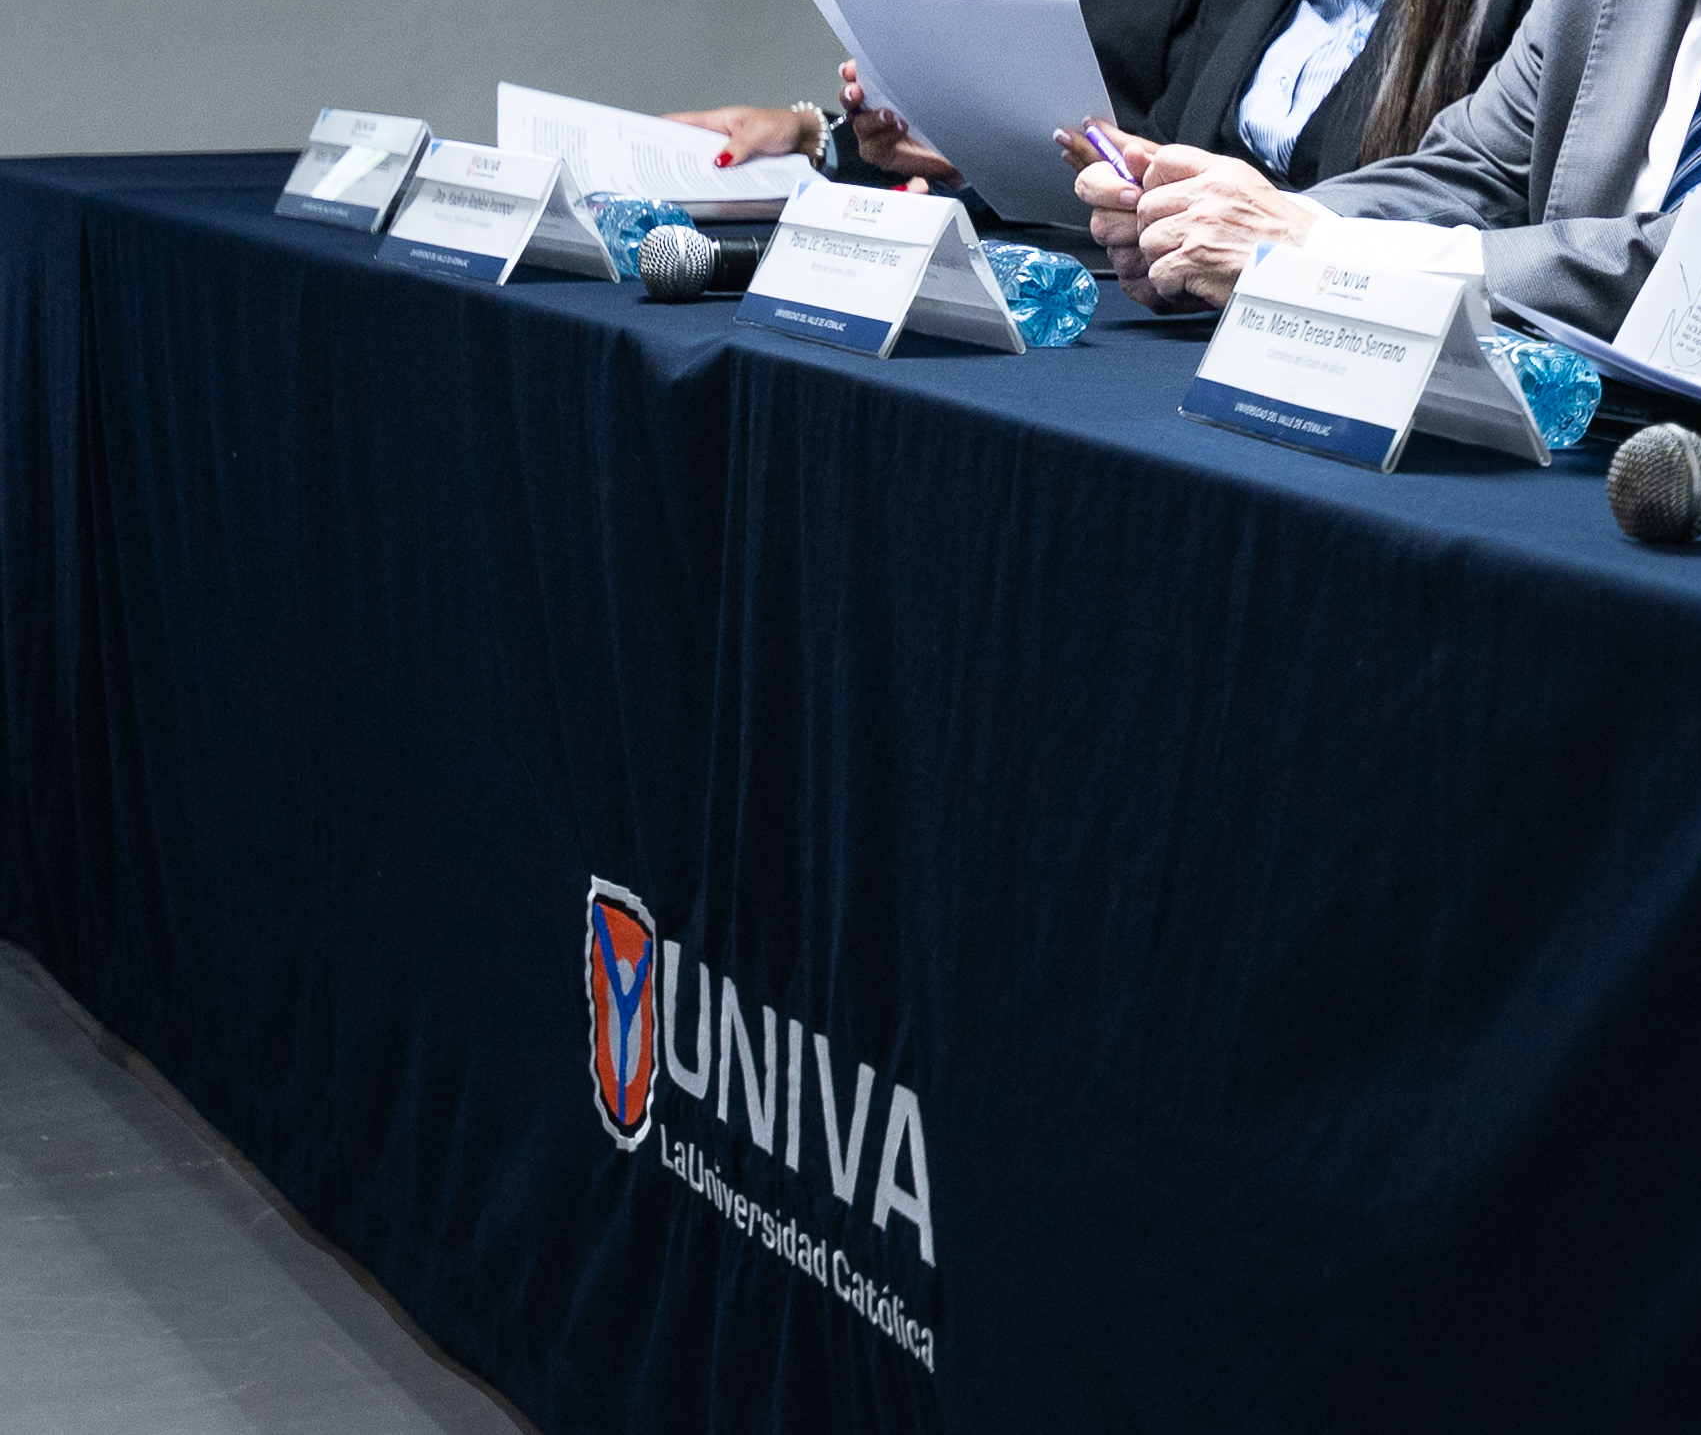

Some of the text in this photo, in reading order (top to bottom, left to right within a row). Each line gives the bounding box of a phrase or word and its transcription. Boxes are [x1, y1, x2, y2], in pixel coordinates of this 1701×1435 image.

[1331, 269, 1371, 292] UNIVA
[1236, 306, 1407, 364] Mtra. María Teresa Brito Serrano
[663, 939, 936, 1269] UNIVA
[832, 1249, 935, 1374] Católica
